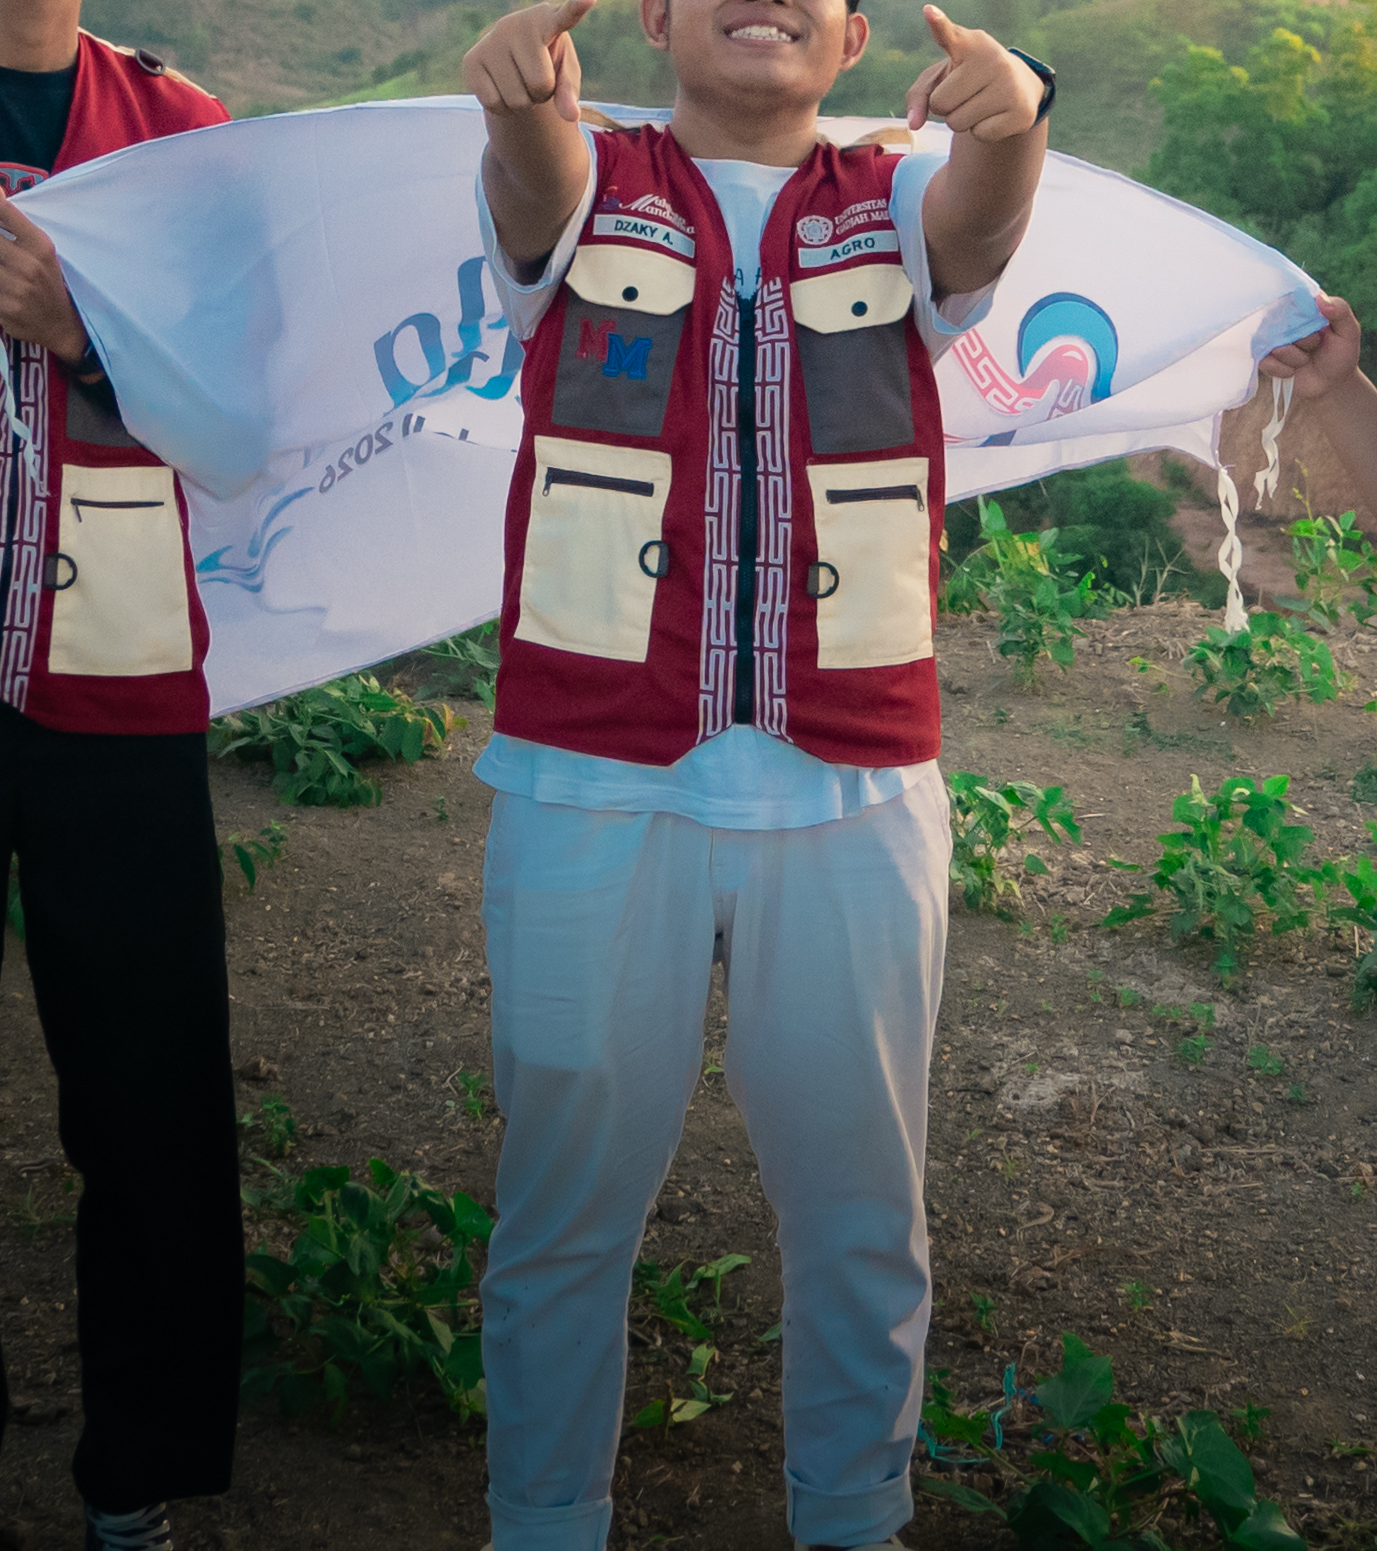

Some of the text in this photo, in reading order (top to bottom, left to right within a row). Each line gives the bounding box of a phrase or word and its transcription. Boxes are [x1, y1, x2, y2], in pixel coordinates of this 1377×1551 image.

[614, 219, 673, 245] DZAKY A.
[830, 237, 876, 260] AGRO
